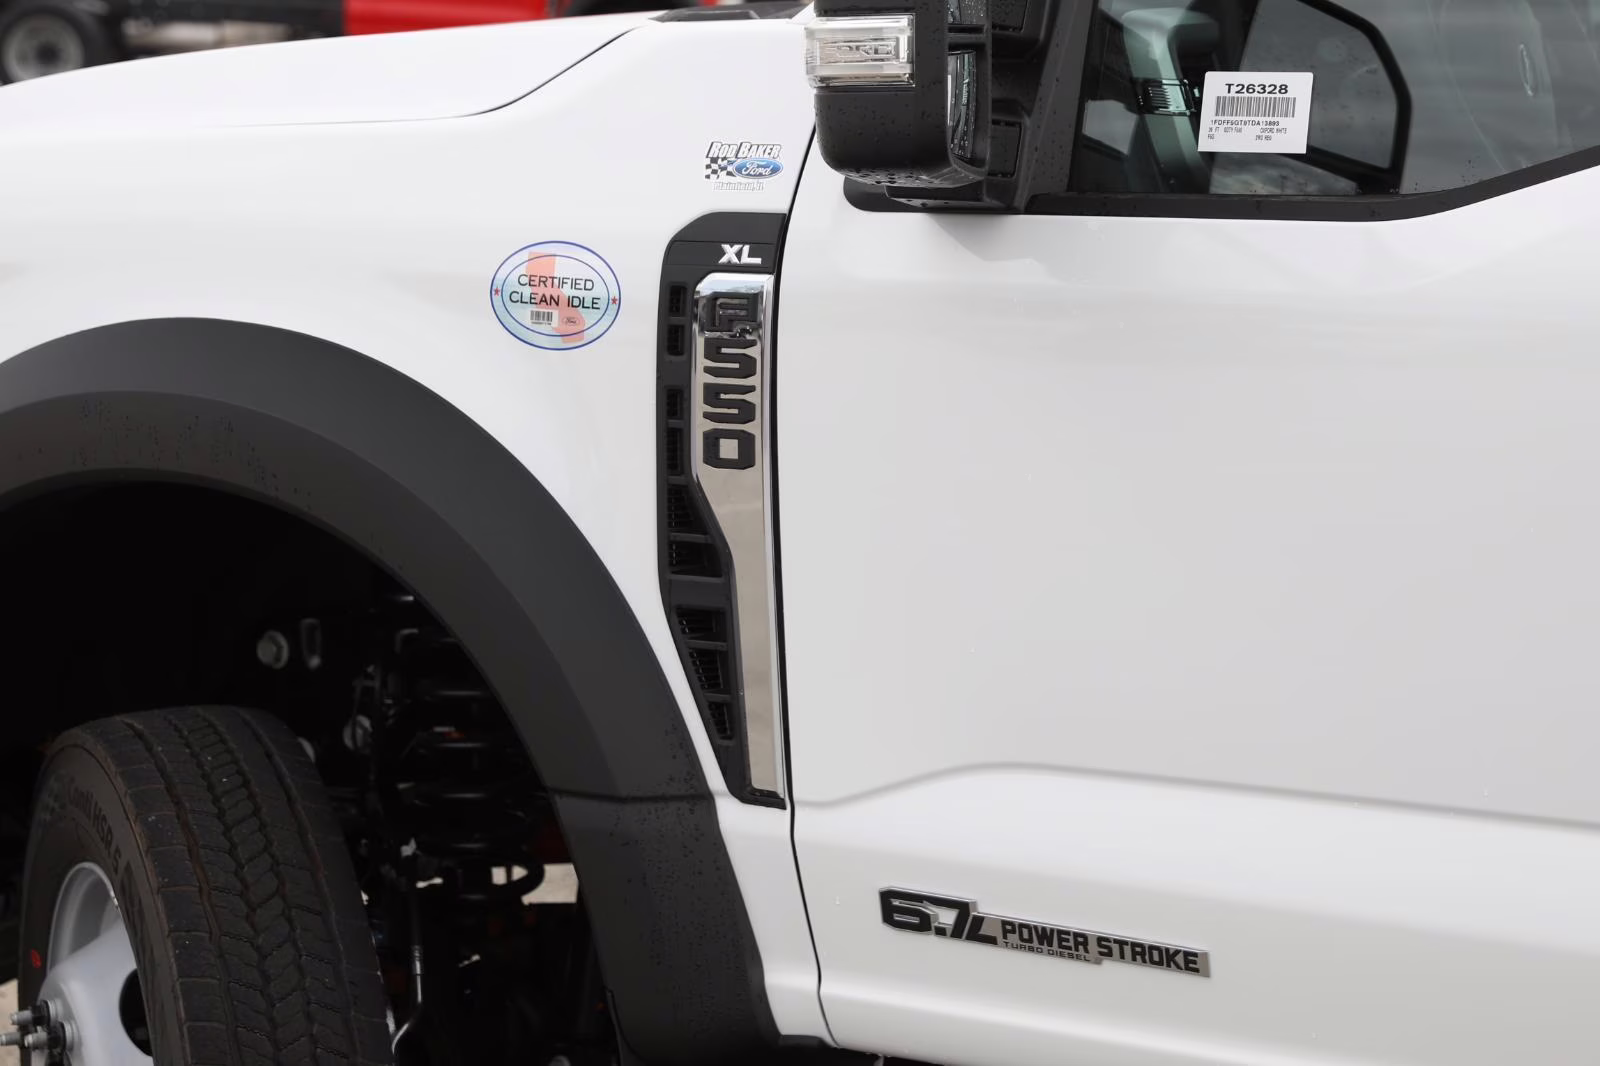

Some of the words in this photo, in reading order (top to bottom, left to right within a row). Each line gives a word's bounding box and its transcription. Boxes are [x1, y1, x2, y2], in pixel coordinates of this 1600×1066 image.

[1225, 83, 1289, 95] T26328
[705, 141, 739, 159] ROD
[735, 141, 783, 160] BAKER
[741, 161, 774, 176] Ford
[718, 243, 763, 265] XL
[517, 273, 595, 292] CERTIFIED
[509, 290, 560, 308] CLEAN
[567, 295, 601, 310] IDLE
[702, 292, 758, 470] F550
[879, 887, 998, 946] 6.7L
[1000, 919, 1090, 955] POWER
[1096, 936, 1201, 974] STROKE
[1002, 941, 1044, 954] TURBO
[1047, 948, 1092, 962] DIESEL
